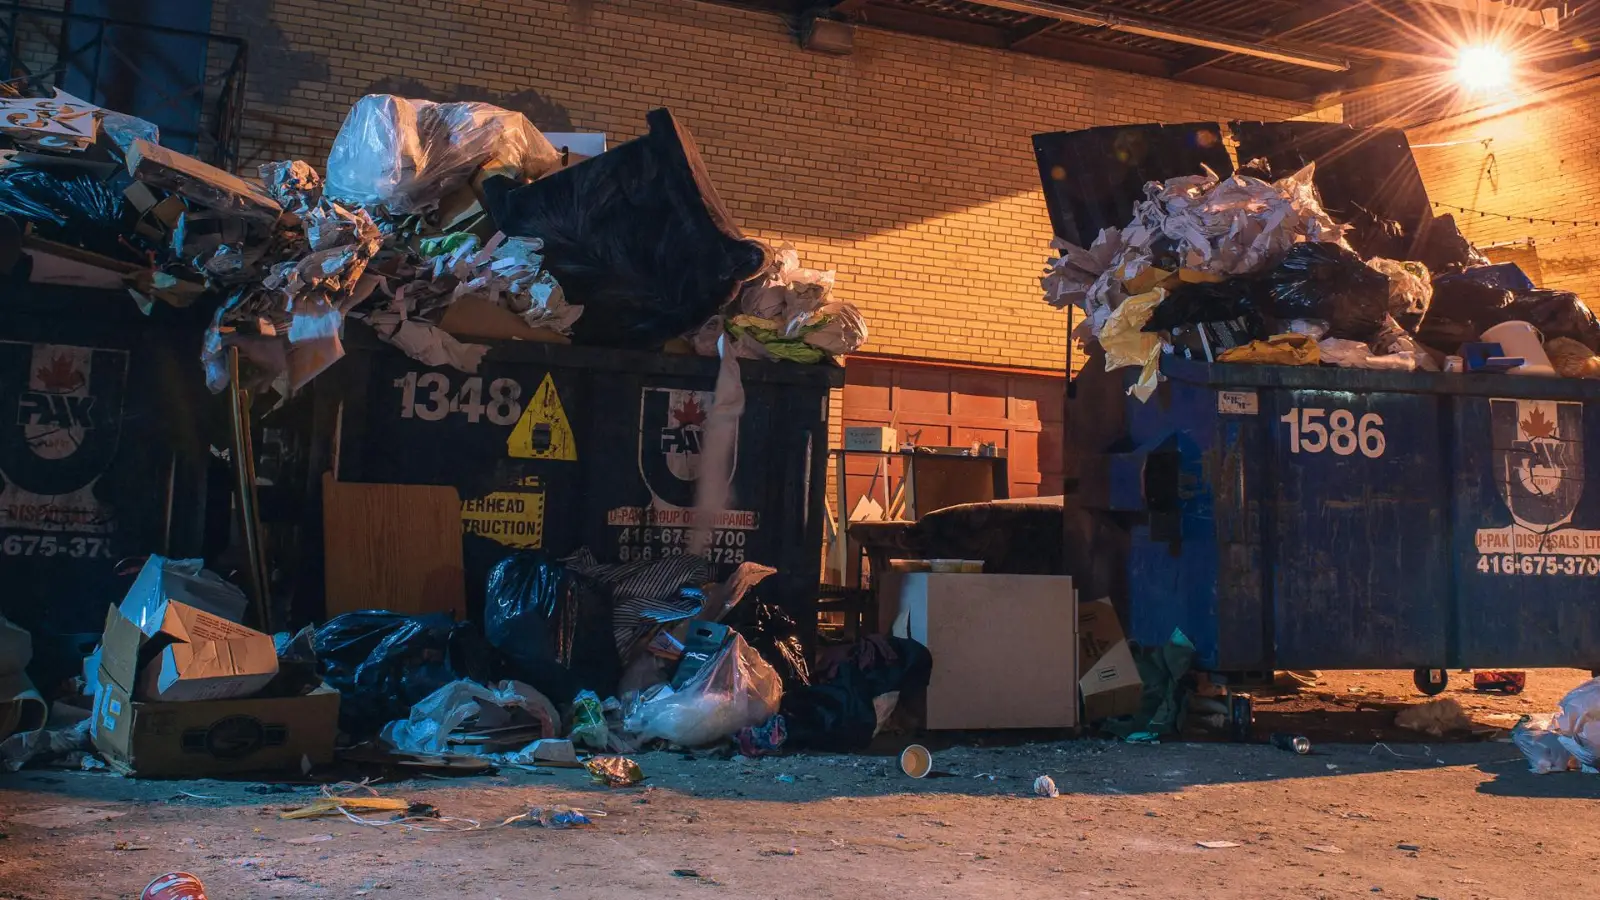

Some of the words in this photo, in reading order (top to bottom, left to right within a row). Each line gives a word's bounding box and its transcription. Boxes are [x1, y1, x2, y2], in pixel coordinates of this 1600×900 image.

[393, 372, 522, 426] 1348
[1281, 408, 1387, 459] 1586
[460, 499, 525, 513] VERHEAD
[463, 519, 536, 535] TRUCTION
[712, 511, 756, 528] MPANIE
[0, 535, 112, 558] 675-37
[618, 528, 746, 547] 416-6753700
[1477, 554, 1600, 576] 416-675-370
